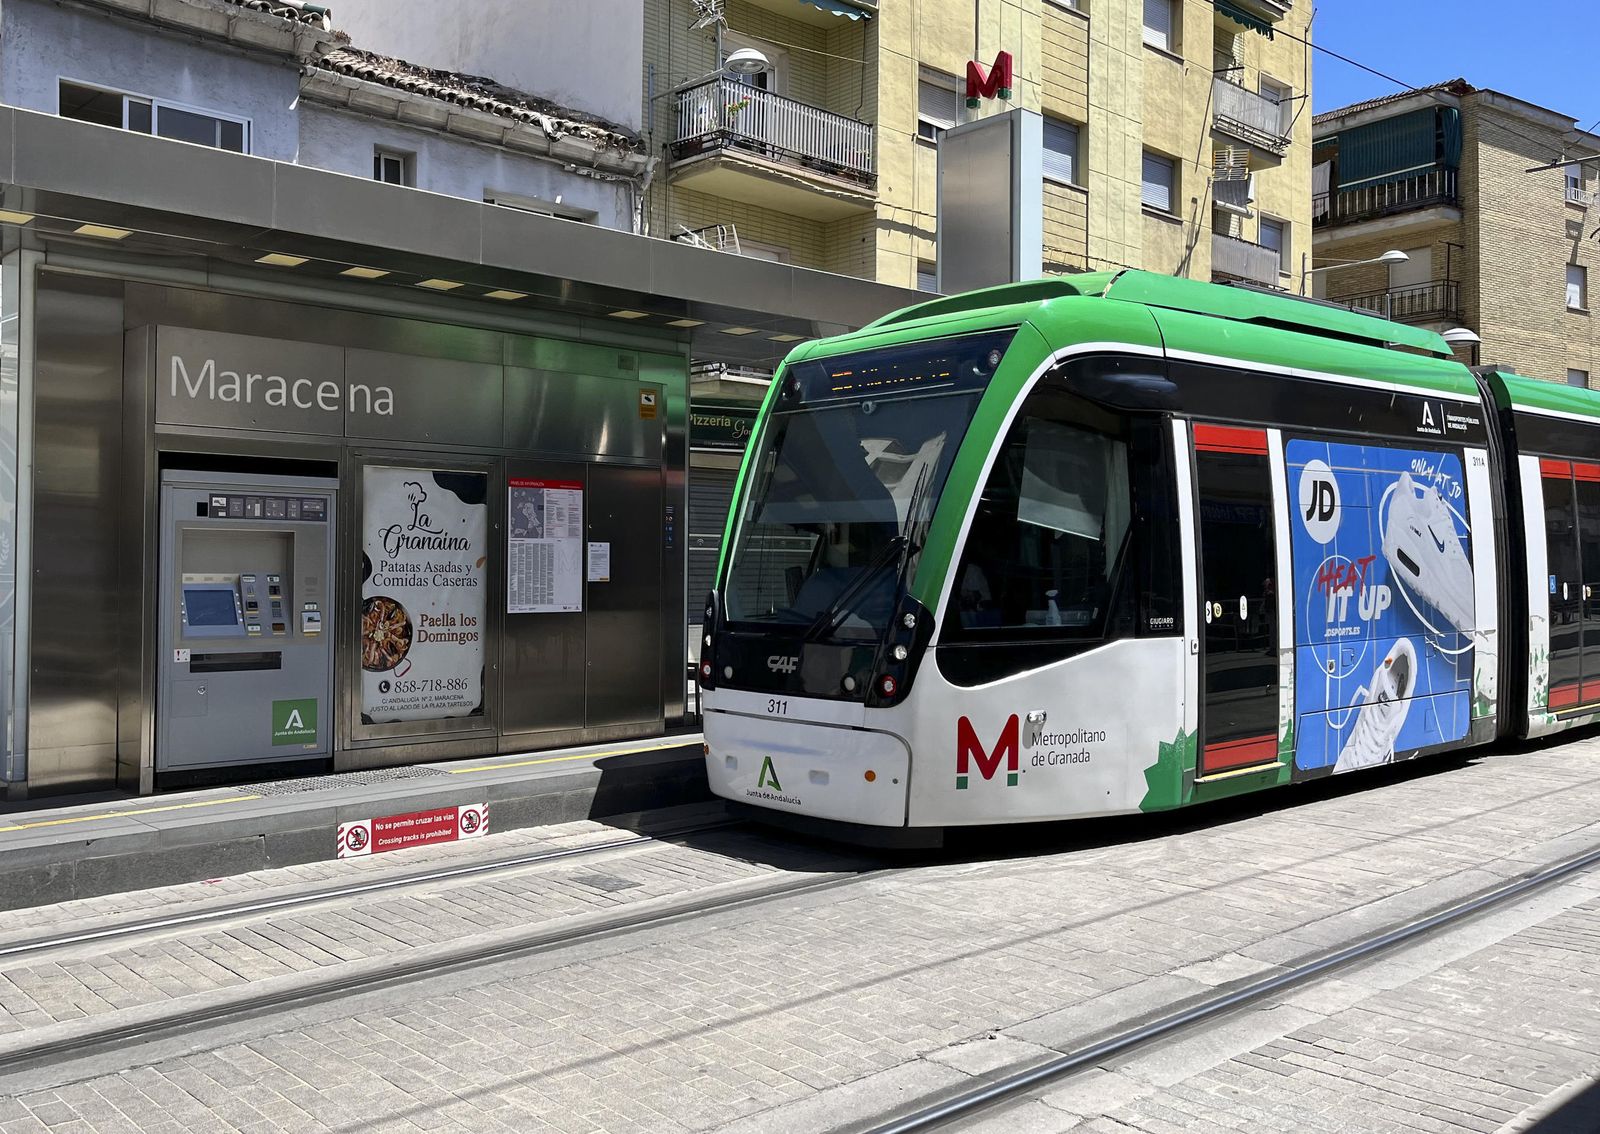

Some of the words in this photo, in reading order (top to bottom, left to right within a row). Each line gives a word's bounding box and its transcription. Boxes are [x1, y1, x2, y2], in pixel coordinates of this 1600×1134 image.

[171, 355, 394, 416] Maracena
[1472, 456, 1486, 467] 311A
[1411, 458, 1435, 481] ONLY
[1434, 471, 1452, 490] AT
[1449, 481, 1462, 499] JD
[1306, 480, 1336, 522] JD
[407, 502, 443, 534] La
[378, 524, 471, 559] Granaina
[380, 560, 421, 573] Patatas
[423, 561, 463, 573] Asadas
[465, 564, 473, 576] y
[1317, 555, 1377, 598] HEAT
[372, 573, 429, 587] Comidas
[432, 574, 478, 587] Caseras
[1327, 586, 1354, 623] IT
[1358, 584, 1392, 622] UP
[419, 613, 457, 627] Paella
[459, 613, 477, 627] los
[416, 628, 479, 646] Domingos
[767, 655, 799, 674] CAF
[394, 678, 468, 694] 858-718-886
[767, 699, 788, 715] 311
[1031, 728, 1106, 749] Metropolitano
[1031, 751, 1045, 767] de
[1047, 747, 1091, 766] Granada
[746, 788, 762, 799] Junta
[375, 822, 384, 831] No
[392, 818, 415, 830] permite
[415, 817, 434, 825] cruzar
[378, 836, 402, 846] Crossing
[402, 832, 419, 842] tracks
[425, 828, 453, 840] prohibited
